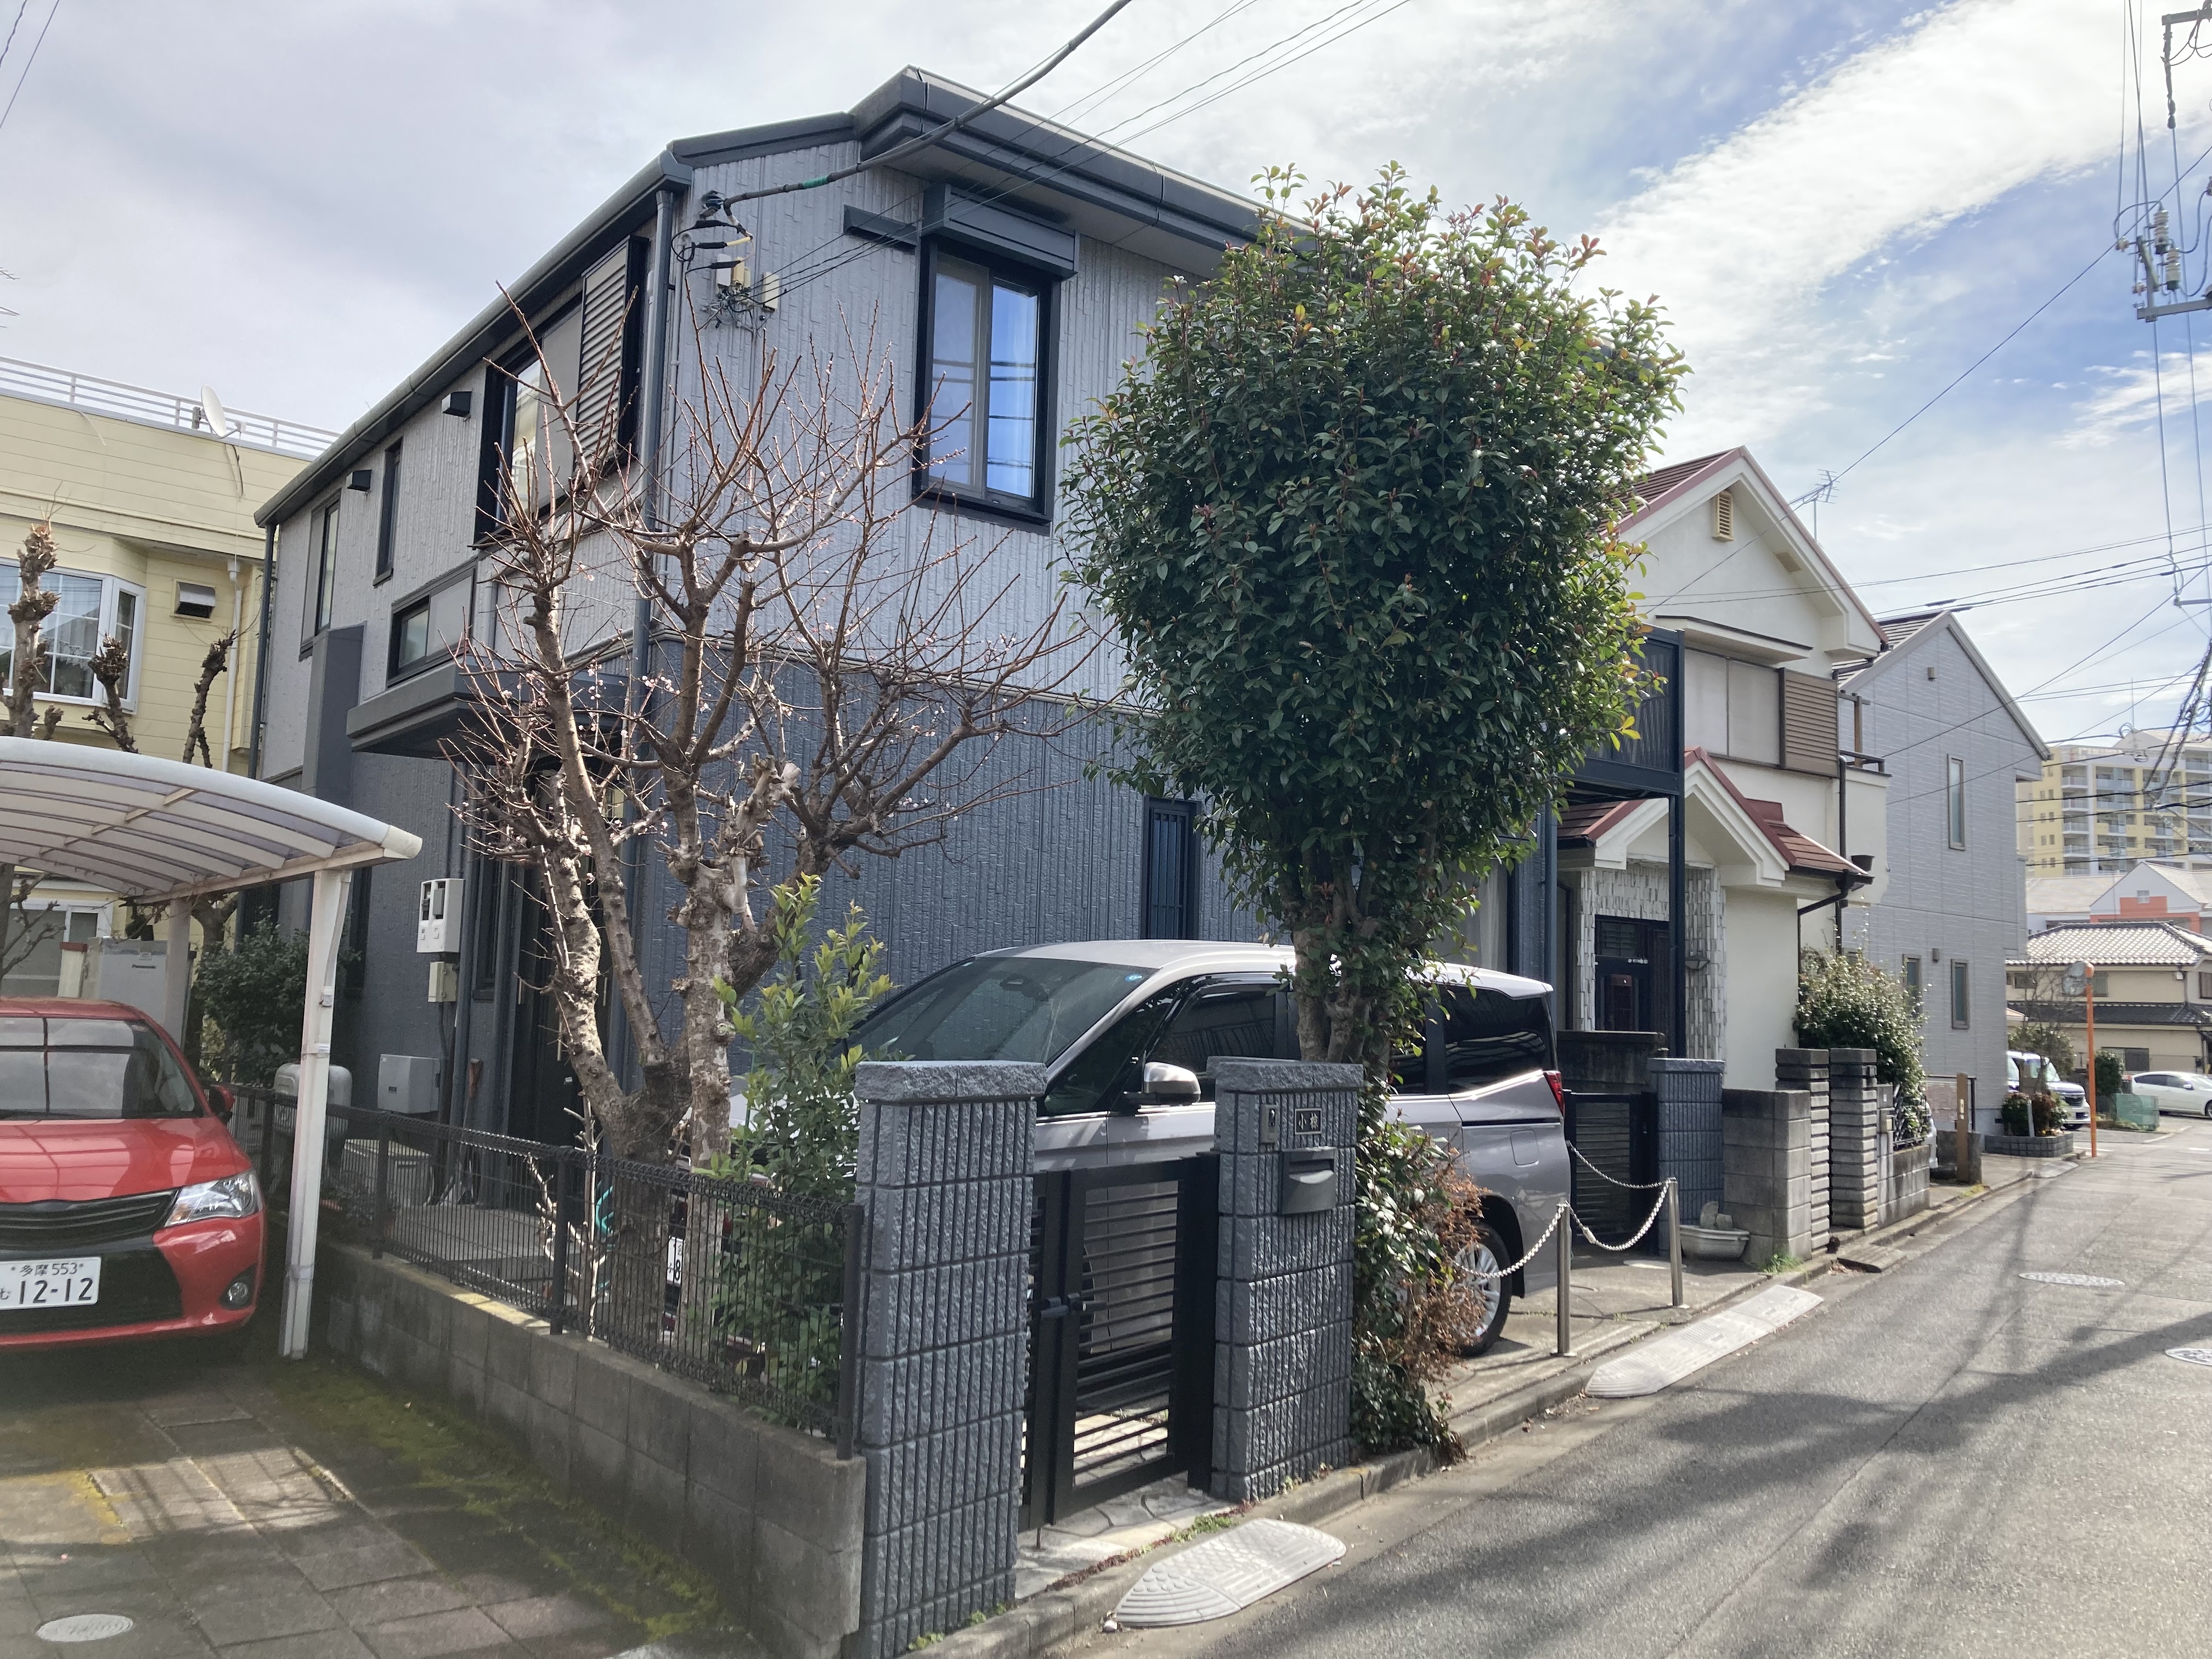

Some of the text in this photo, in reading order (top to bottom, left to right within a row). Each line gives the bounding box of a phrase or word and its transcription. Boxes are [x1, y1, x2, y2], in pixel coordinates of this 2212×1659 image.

[19, 1262, 77, 1277] 多摩 553
[19, 1277, 93, 1305] 12-12
